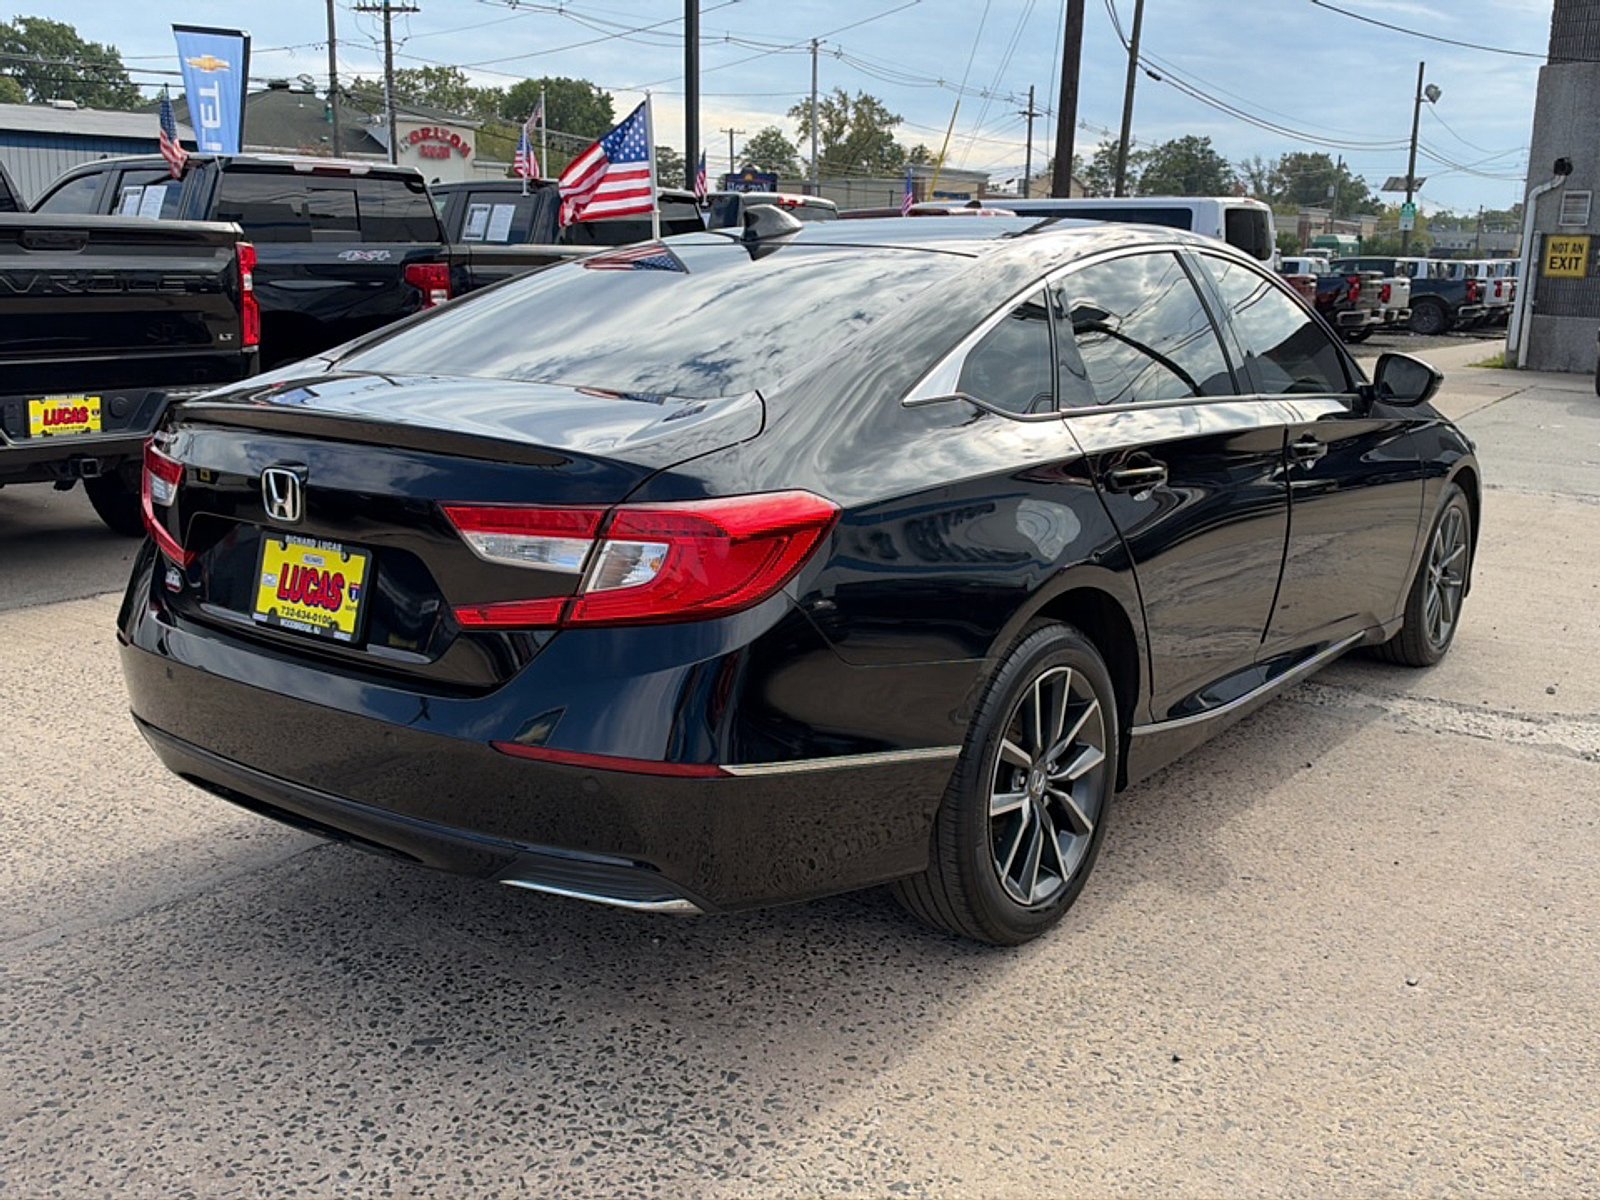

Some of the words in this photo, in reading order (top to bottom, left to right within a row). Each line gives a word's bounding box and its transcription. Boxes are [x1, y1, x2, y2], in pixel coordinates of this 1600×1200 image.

[1551, 242, 1569, 254] NOT
[1571, 243, 1585, 254] AN
[1549, 256, 1582, 270] EXIT
[219, 333, 234, 341] LT
[43, 406, 89, 426] LUCAS
[284, 535, 317, 547] RICHARD
[318, 541, 343, 552] LUCAS
[277, 563, 345, 612] LUCAS
